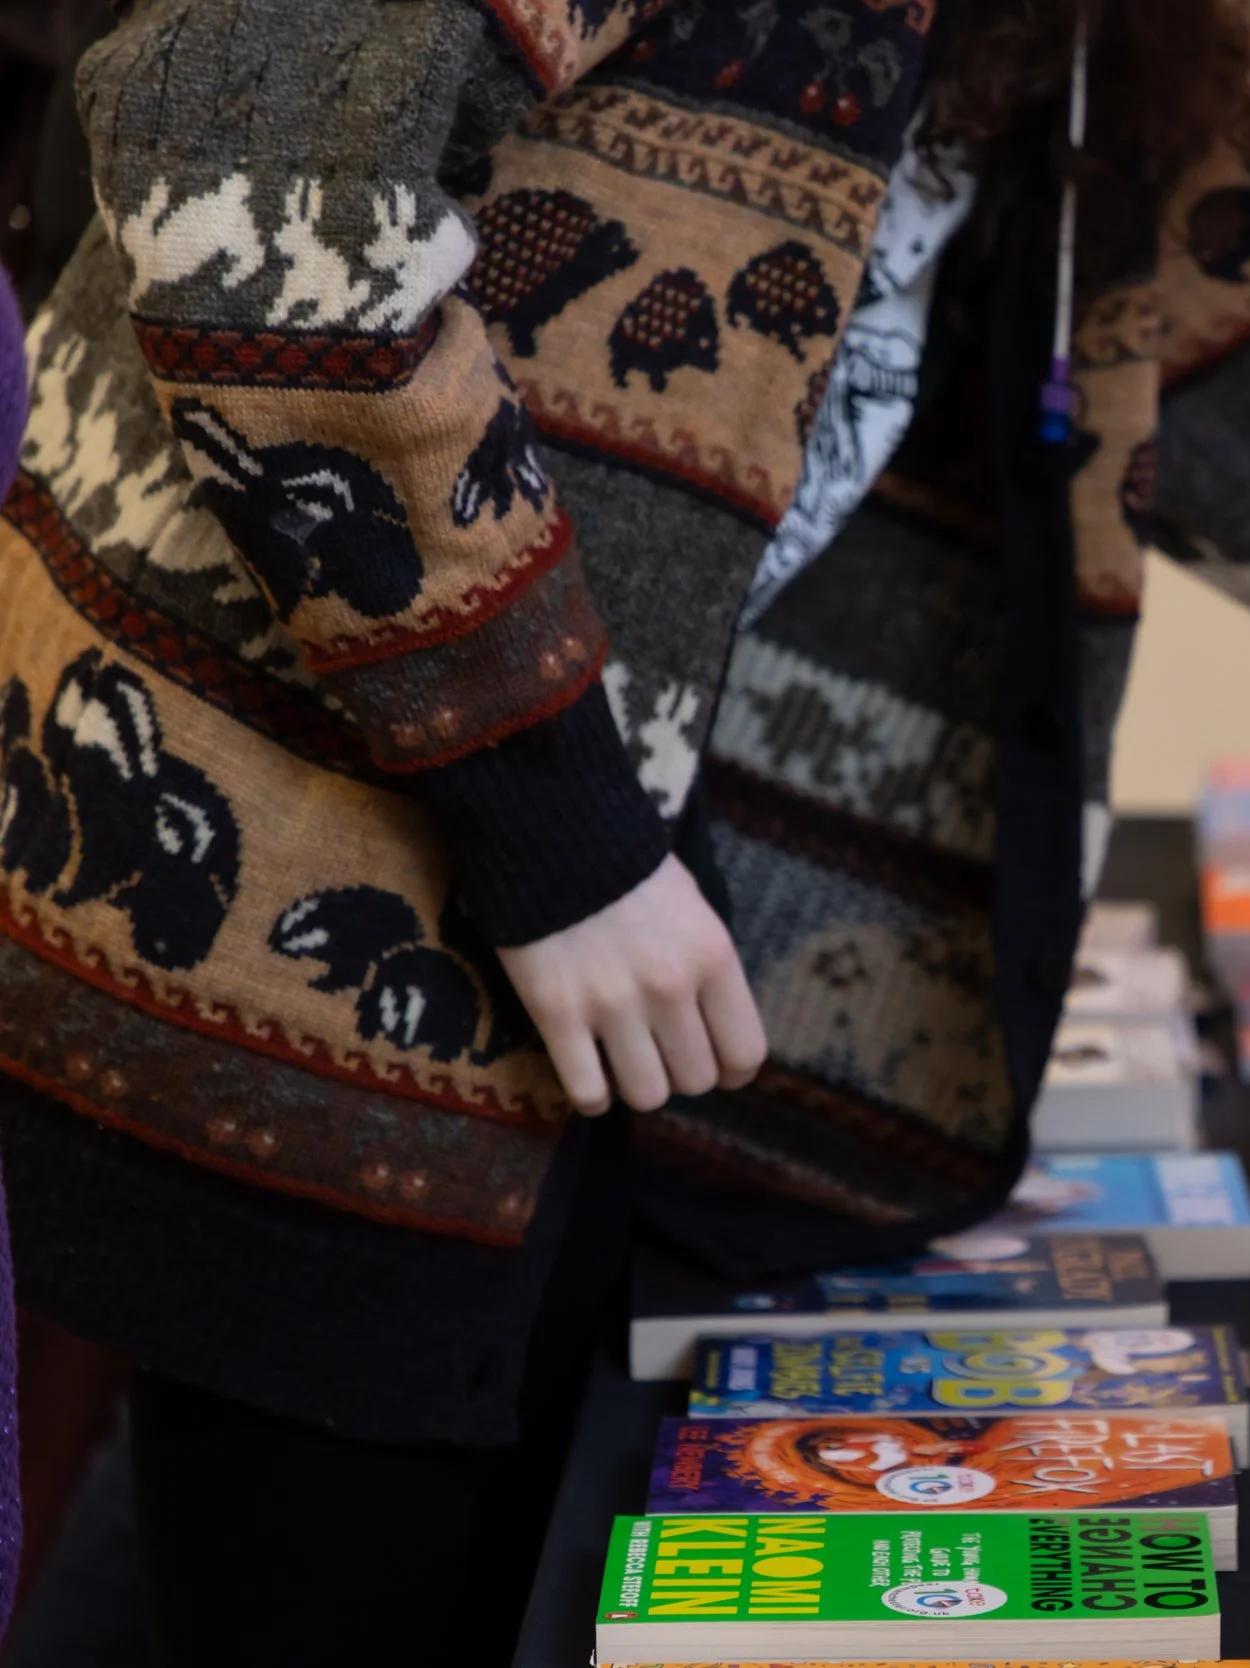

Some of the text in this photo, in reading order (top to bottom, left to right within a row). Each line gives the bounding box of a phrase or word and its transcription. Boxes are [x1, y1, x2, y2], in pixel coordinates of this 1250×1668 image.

[925, 1330, 1074, 1408] BOB
[669, 1425, 708, 1489] LEE NEWBERY
[996, 1419, 1113, 1495] FIREFOX
[1119, 1432, 1213, 1477] LAST
[618, 1521, 651, 1607] WITH REBECCA STEFOFF
[647, 1519, 748, 1615] KLEIN
[747, 1518, 826, 1614] NAOMI
[868, 1539, 892, 1587] AND EACH OTHER
[903, 1565, 922, 1577] THE
[929, 1548, 951, 1576] GUIDE TO
[965, 1588, 986, 1606] take
[1031, 1519, 1072, 1611] EVERYTHING
[1138, 1518, 1209, 1609] HOW TO
[914, 1589, 963, 1609] 10
